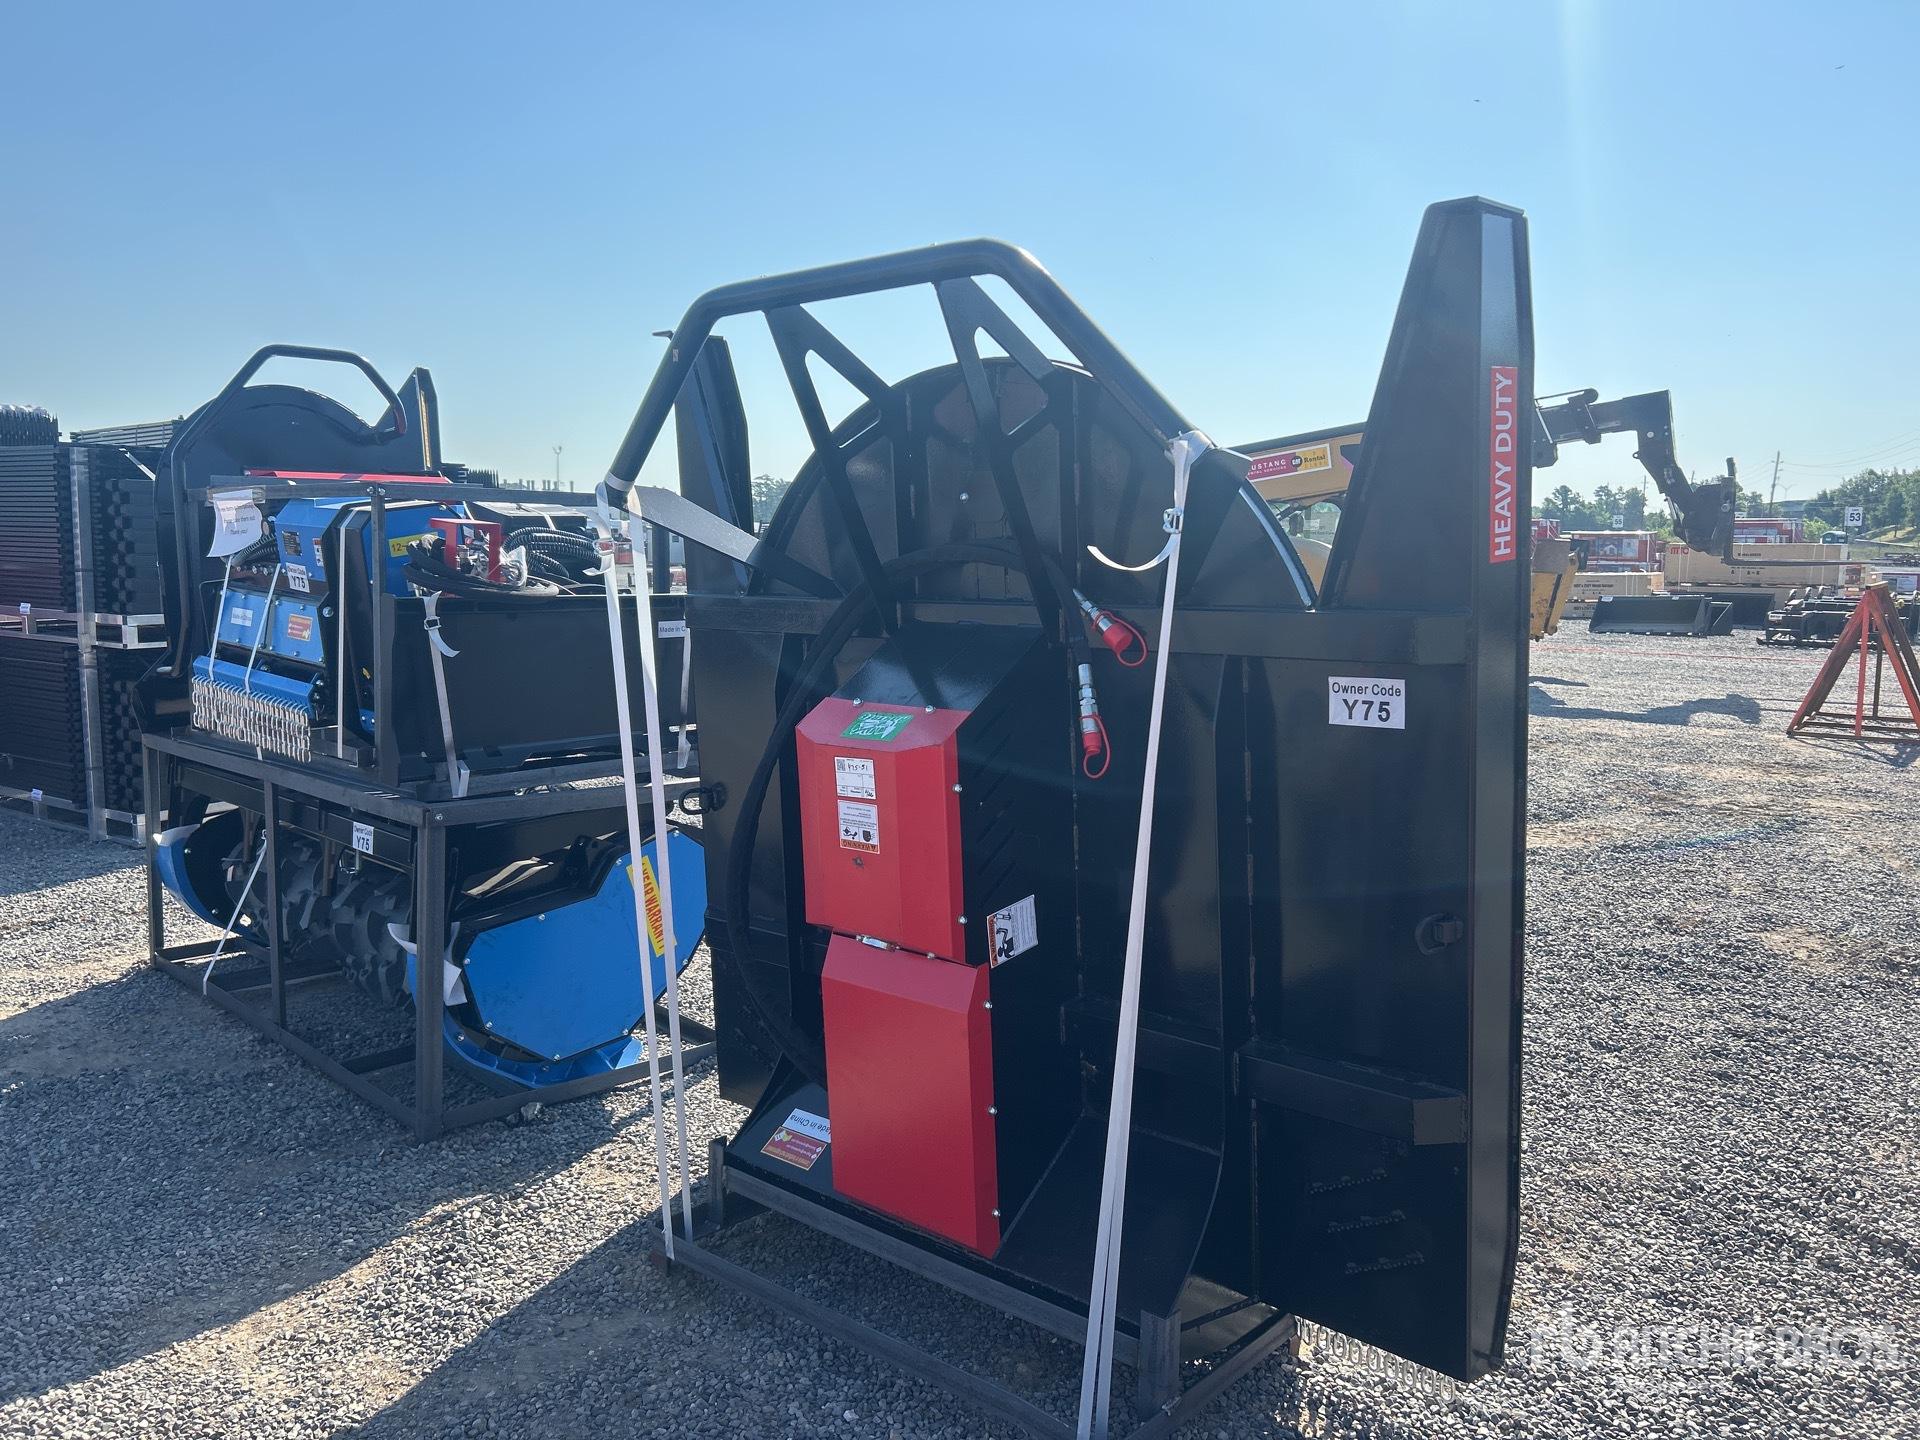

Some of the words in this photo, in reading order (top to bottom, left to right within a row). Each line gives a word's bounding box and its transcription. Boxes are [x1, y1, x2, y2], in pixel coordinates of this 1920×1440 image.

[1495, 372, 1513, 453] DUTY
[1250, 459, 1287, 471] USTANG
[1494, 461, 1512, 556] HEAVY
[1849, 512, 1861, 522] 53
[291, 575, 306, 589] Y75
[1332, 682, 1369, 695] Owner
[1371, 684, 1402, 697] Code
[1342, 699, 1391, 722] Y75
[356, 836, 370, 851] Y75
[842, 839, 871, 851] WARNING
[988, 914, 998, 954] WARNING
[790, 1114, 810, 1127] China
[818, 1123, 831, 1135] ade
